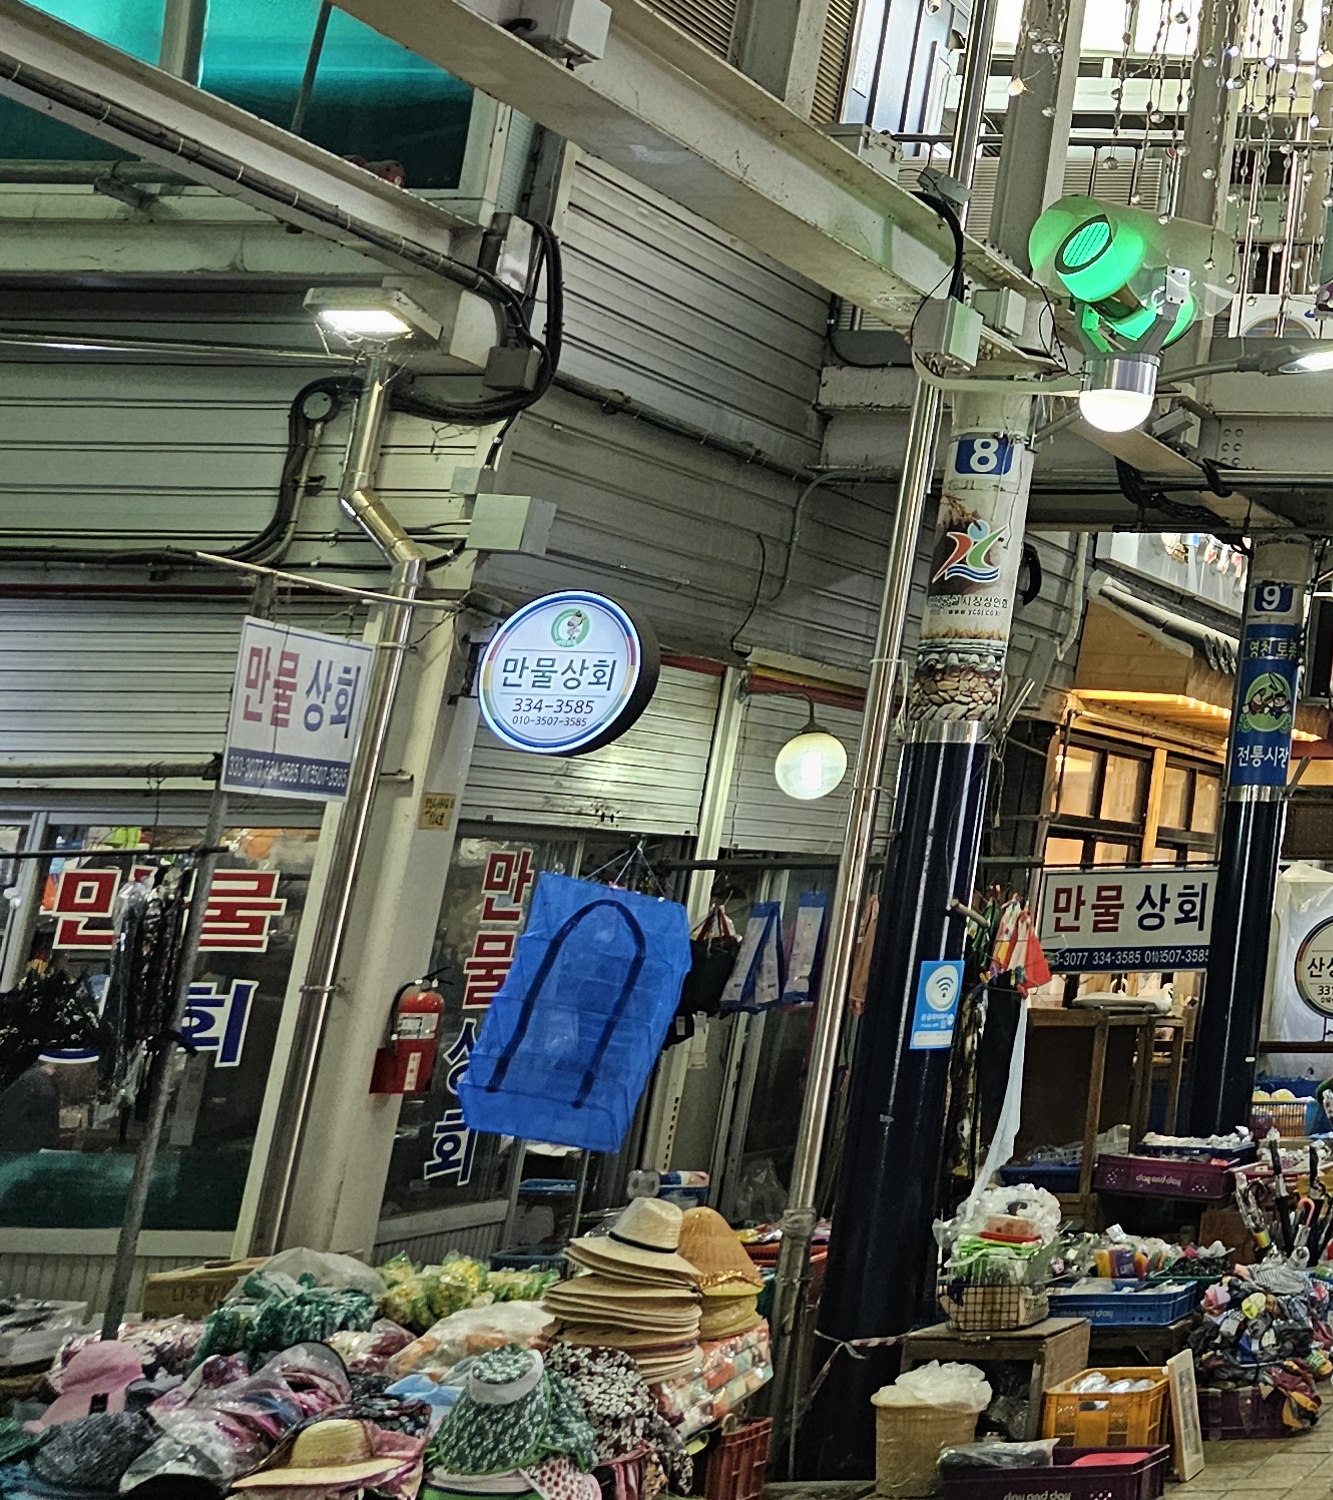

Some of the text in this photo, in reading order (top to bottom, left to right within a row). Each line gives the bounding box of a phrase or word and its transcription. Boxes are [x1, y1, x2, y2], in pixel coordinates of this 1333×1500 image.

[969, 438, 998, 473] 8
[1261, 585, 1281, 611] 9
[1250, 640, 1272, 658] 영천
[502, 657, 617, 691] 만물상회
[512, 698, 595, 714] 334-3585
[512, 715, 587, 727] 010-3507-3585
[1237, 746, 1289, 768] 전통시장
[1093, 951, 1141, 965] 334-3585
